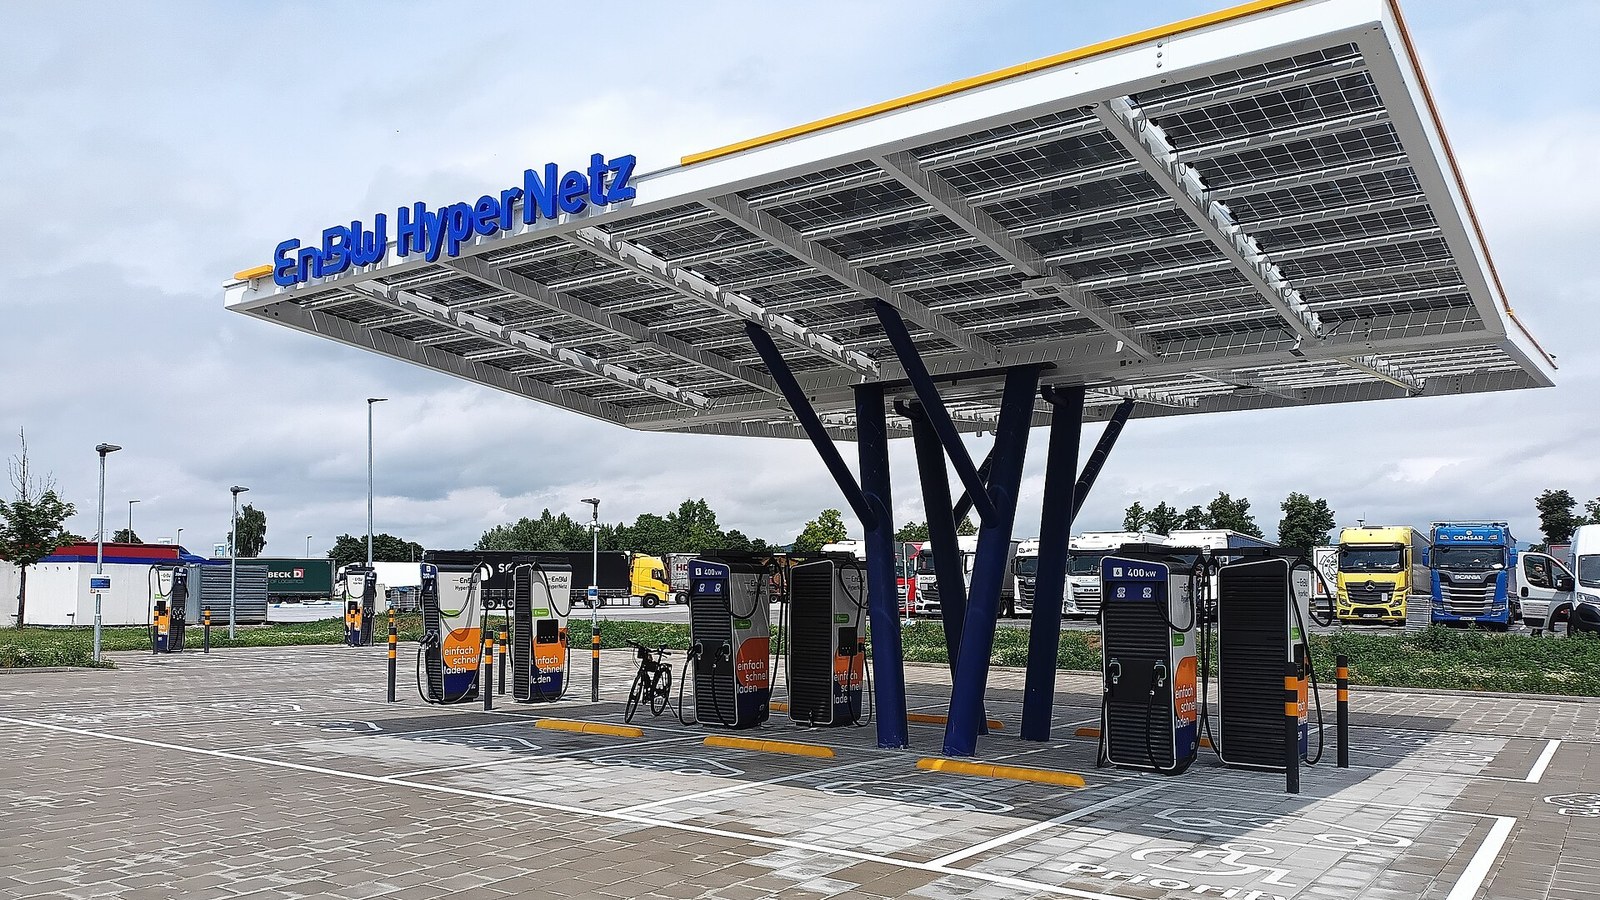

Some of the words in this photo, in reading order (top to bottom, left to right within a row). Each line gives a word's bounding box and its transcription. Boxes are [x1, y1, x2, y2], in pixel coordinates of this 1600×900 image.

[272, 213, 388, 287] EnBW
[397, 153, 637, 263] HyperNetz
[1127, 568, 1145, 577] 400
[445, 645, 474, 656] einfach
[737, 658, 765, 671] einfach
[1175, 684, 1194, 699] einfach
